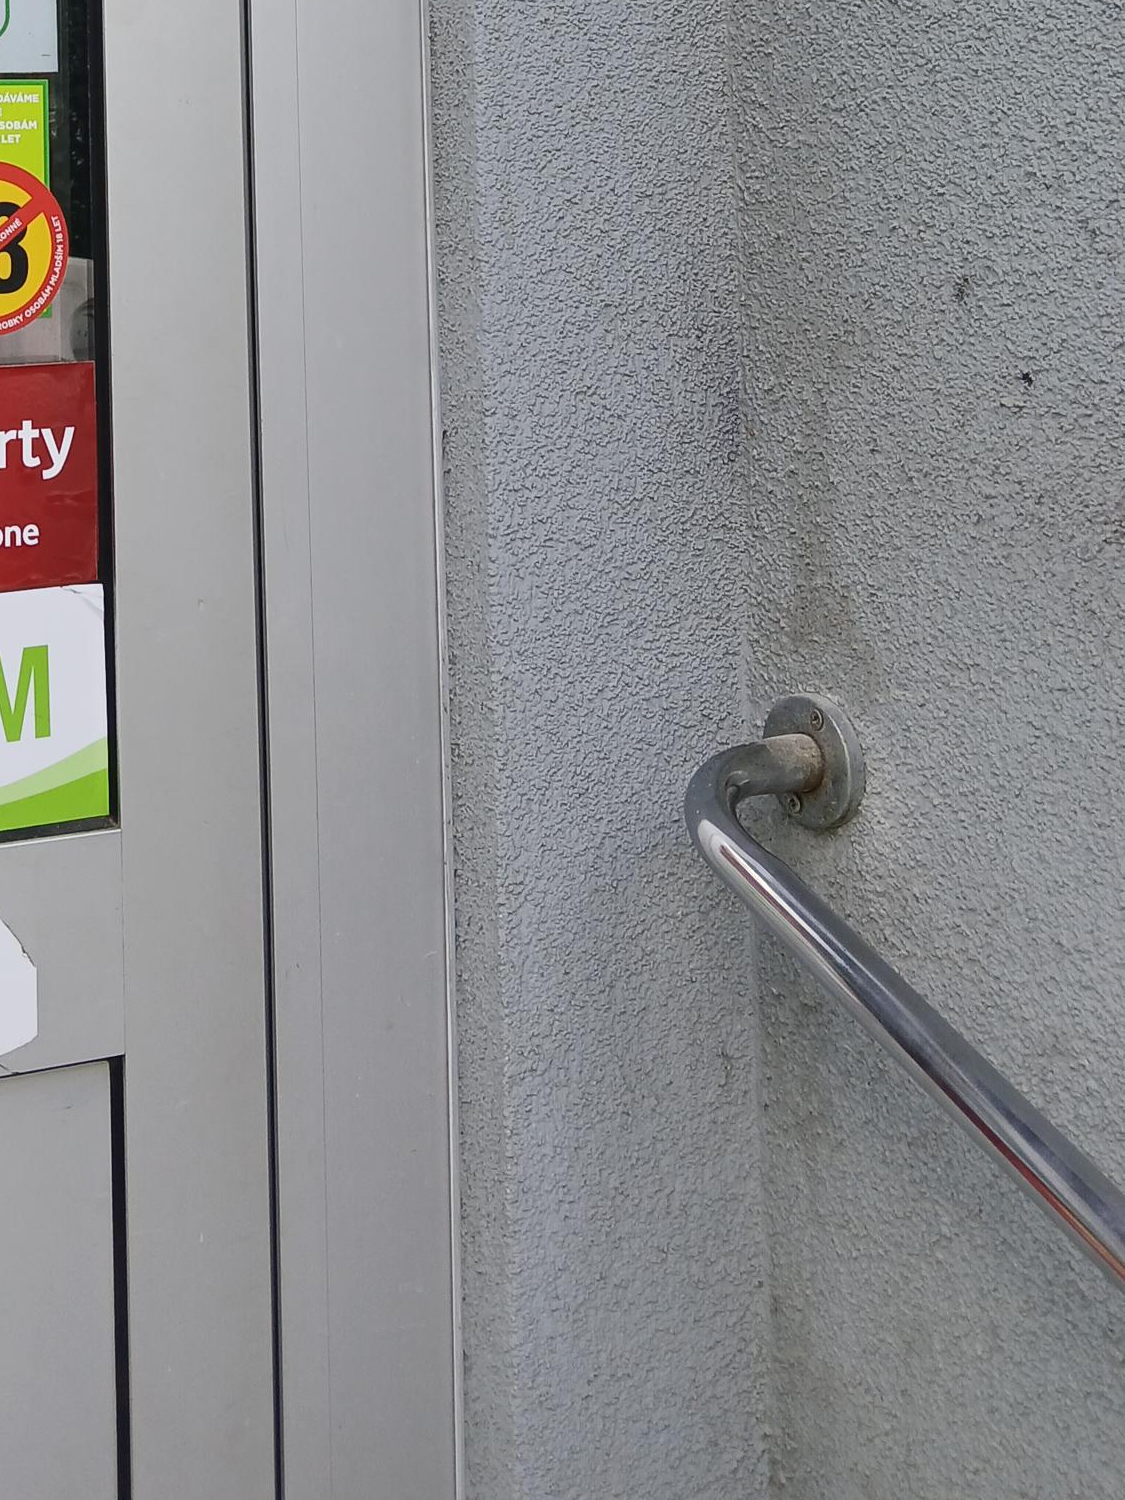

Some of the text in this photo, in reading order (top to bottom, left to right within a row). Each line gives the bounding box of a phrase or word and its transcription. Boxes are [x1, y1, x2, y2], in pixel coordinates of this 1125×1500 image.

[1, 134, 21, 144] LET
[24, 285, 53, 317] OSOBÁM
[51, 215, 63, 233] LET
